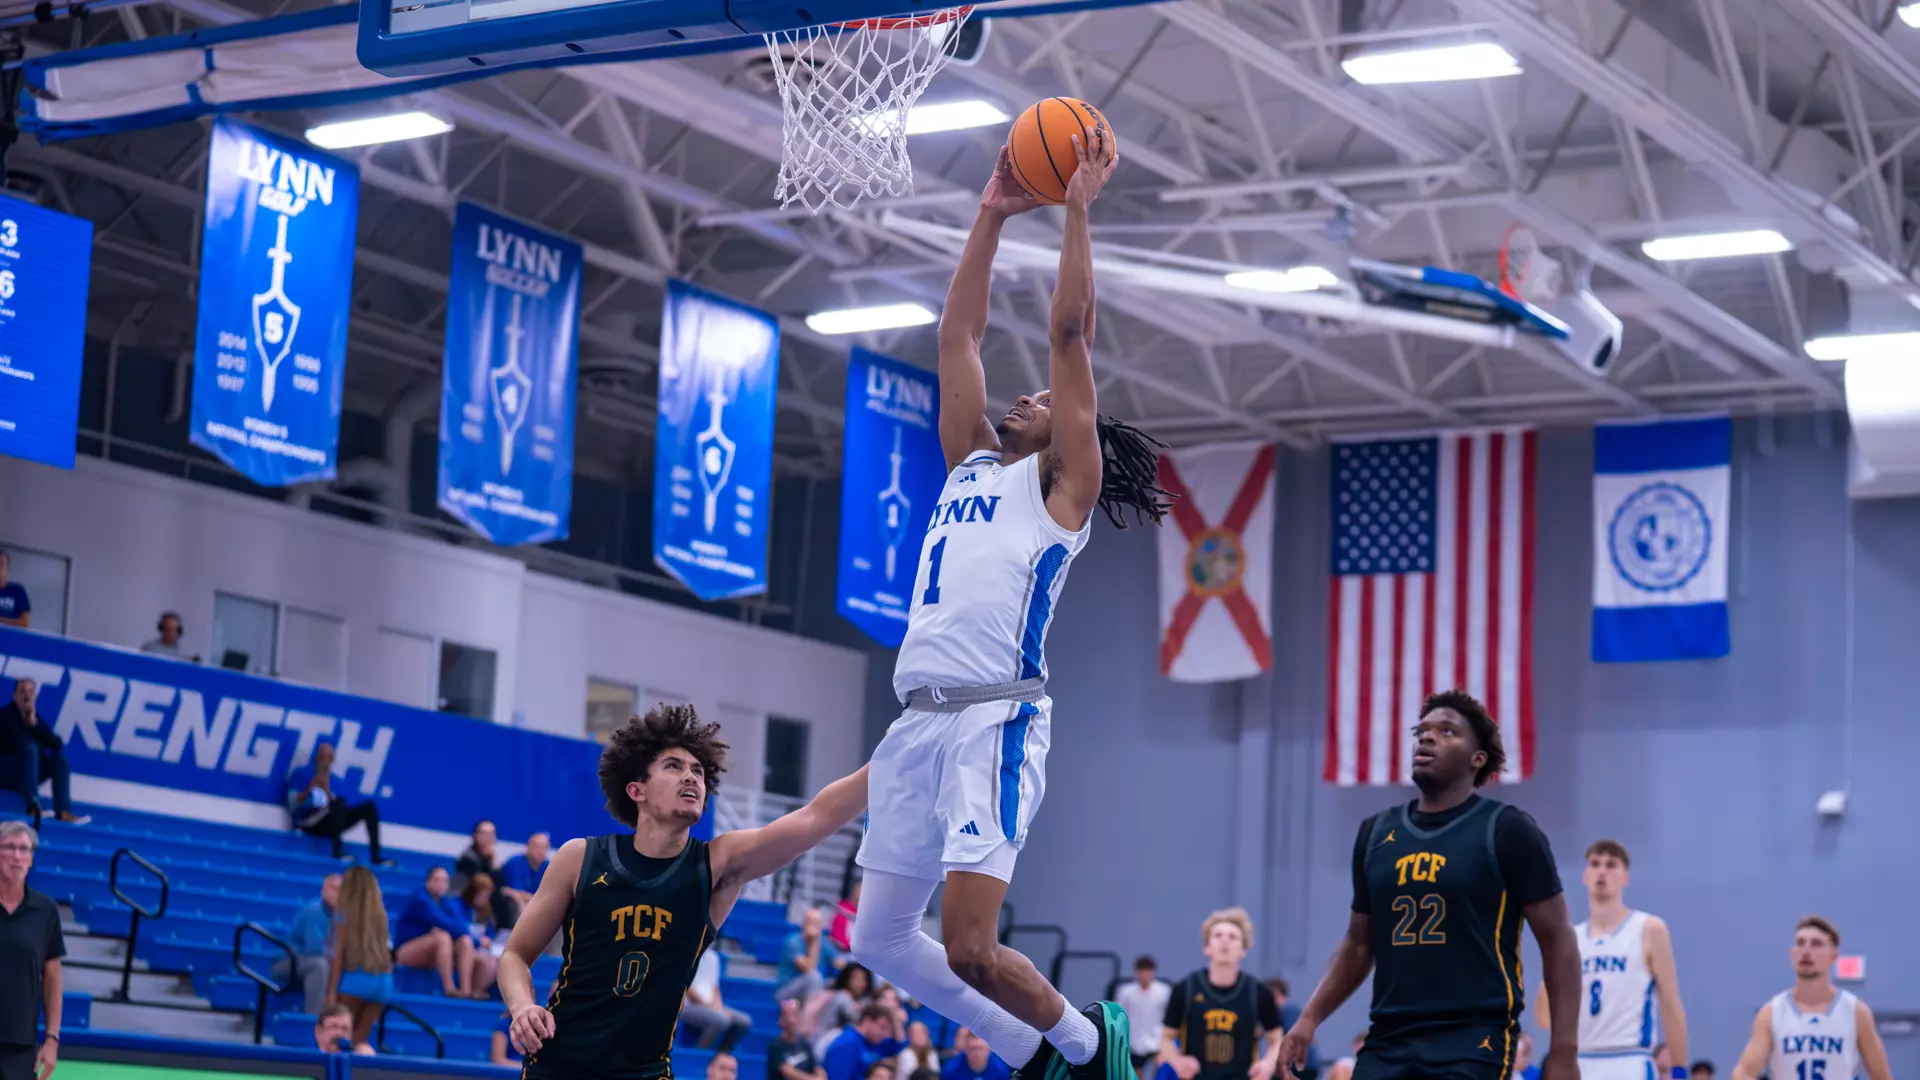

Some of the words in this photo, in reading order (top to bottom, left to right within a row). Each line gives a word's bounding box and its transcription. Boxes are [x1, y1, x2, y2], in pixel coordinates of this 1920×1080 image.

[237, 138, 335, 206] LYNN
[259, 186, 308, 217] GOLF
[477, 223, 562, 283] LYNN
[486, 262, 550, 298] SOCCER
[264, 311, 284, 344] 5
[866, 364, 934, 414] LYNN
[926, 494, 1001, 533] YNN
[923, 535, 948, 605] 1
[0, 654, 395, 799] TRENGTH.
[1395, 852, 1446, 886] TCF
[611, 904, 673, 941] TCF
[1392, 893, 1446, 946] 22
[613, 951, 650, 997] 0
[1203, 1008, 1239, 1032] TCF
[1783, 1035, 1844, 1055] LYNN
